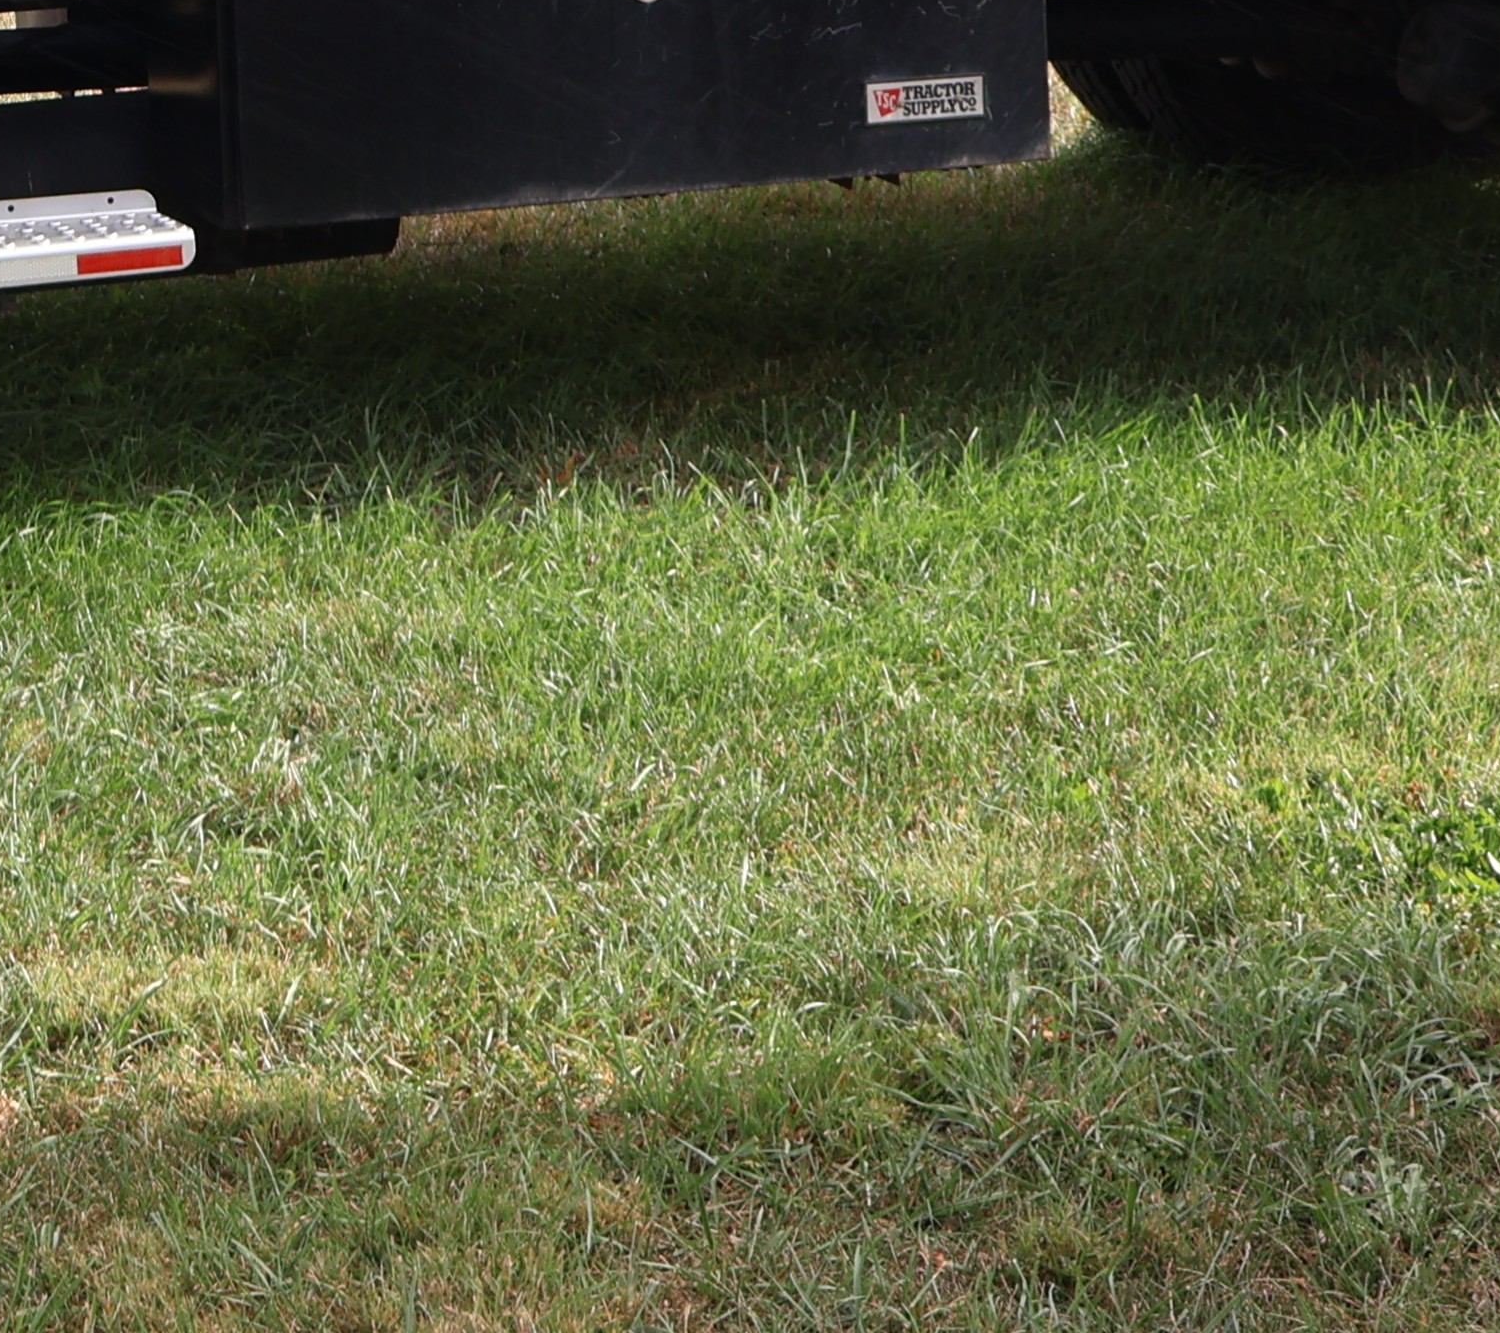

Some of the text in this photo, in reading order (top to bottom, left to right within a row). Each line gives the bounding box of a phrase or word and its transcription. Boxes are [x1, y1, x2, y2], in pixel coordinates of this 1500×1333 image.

[875, 89, 898, 111] TSC
[902, 82, 976, 100] TRACTOR
[903, 99, 958, 116] SUPPLY
